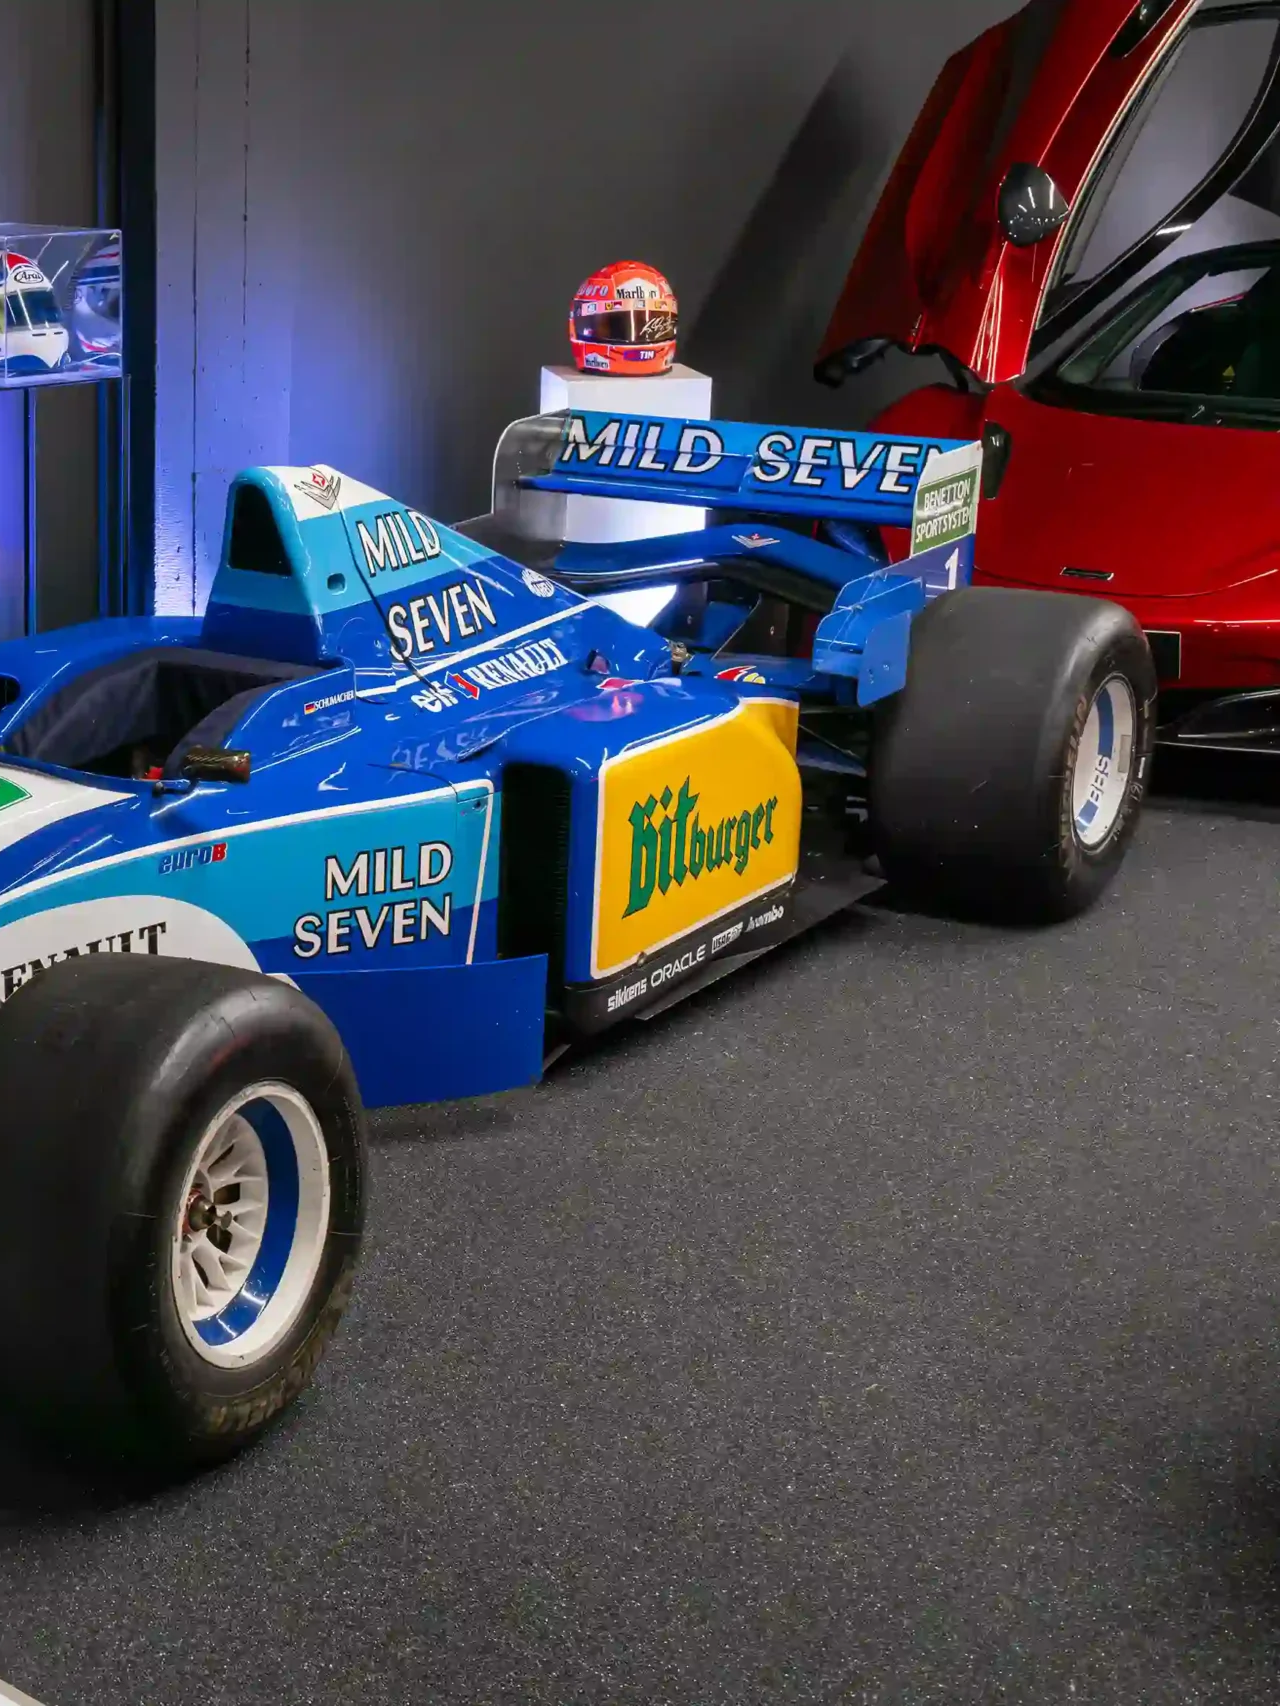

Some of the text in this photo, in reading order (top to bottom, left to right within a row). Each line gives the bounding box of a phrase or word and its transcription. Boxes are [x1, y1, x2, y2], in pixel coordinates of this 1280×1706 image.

[640, 350, 655, 359] TIM
[562, 416, 724, 475] MILD
[924, 478, 970, 512] BENETTON
[356, 509, 442, 578] MILD
[945, 548, 959, 590] 1
[387, 578, 497, 662] SEVEN
[410, 637, 569, 713] elf RENAULT
[158, 842, 228, 875] euroB
[324, 840, 454, 901] MILD
[622, 775, 779, 919] Bitburger
[293, 893, 453, 959] SEVEN
[650, 944, 707, 988] ORACLE
